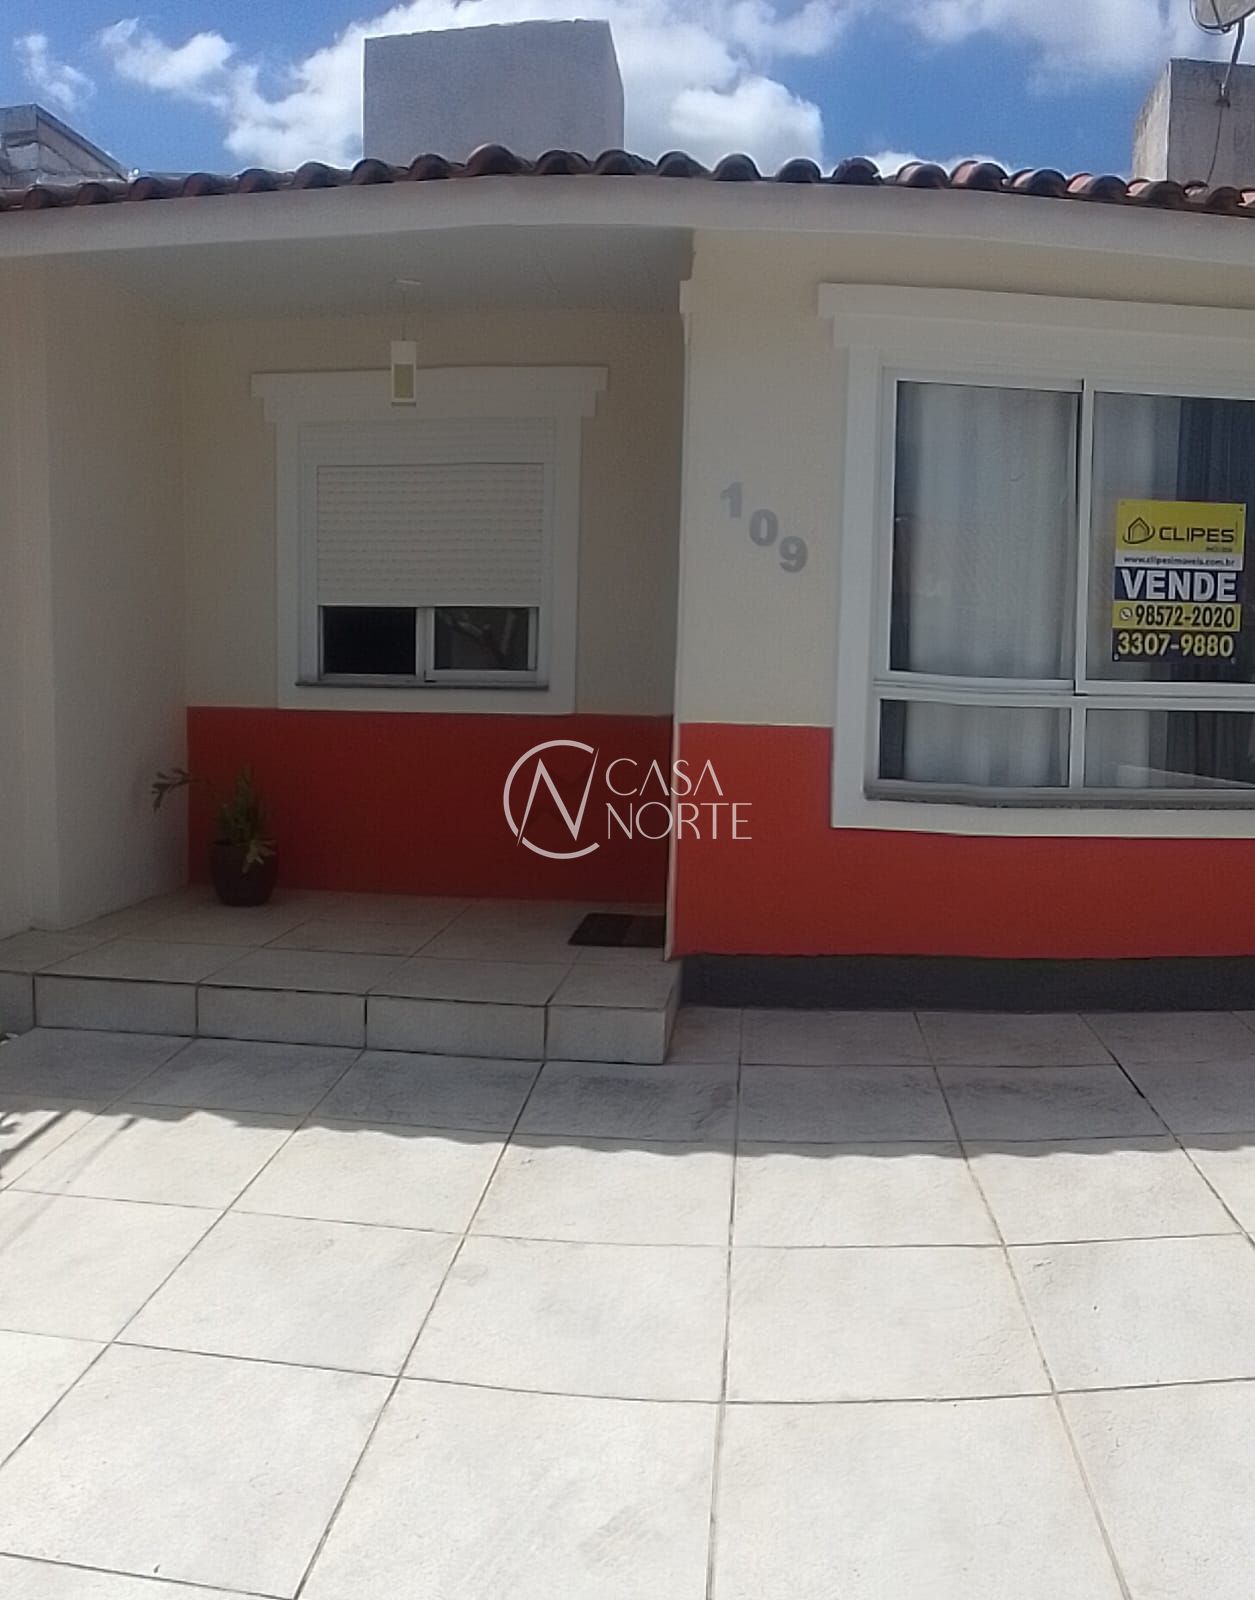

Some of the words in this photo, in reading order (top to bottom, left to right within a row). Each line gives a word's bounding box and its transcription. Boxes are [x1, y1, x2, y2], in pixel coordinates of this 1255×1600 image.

[720, 481, 808, 573] 109
[1159, 527, 1234, 543] CLIPES
[1121, 569, 1237, 602] VENDE
[1136, 605, 1234, 628] 98572-2020
[1118, 632, 1234, 657] 3307-9880
